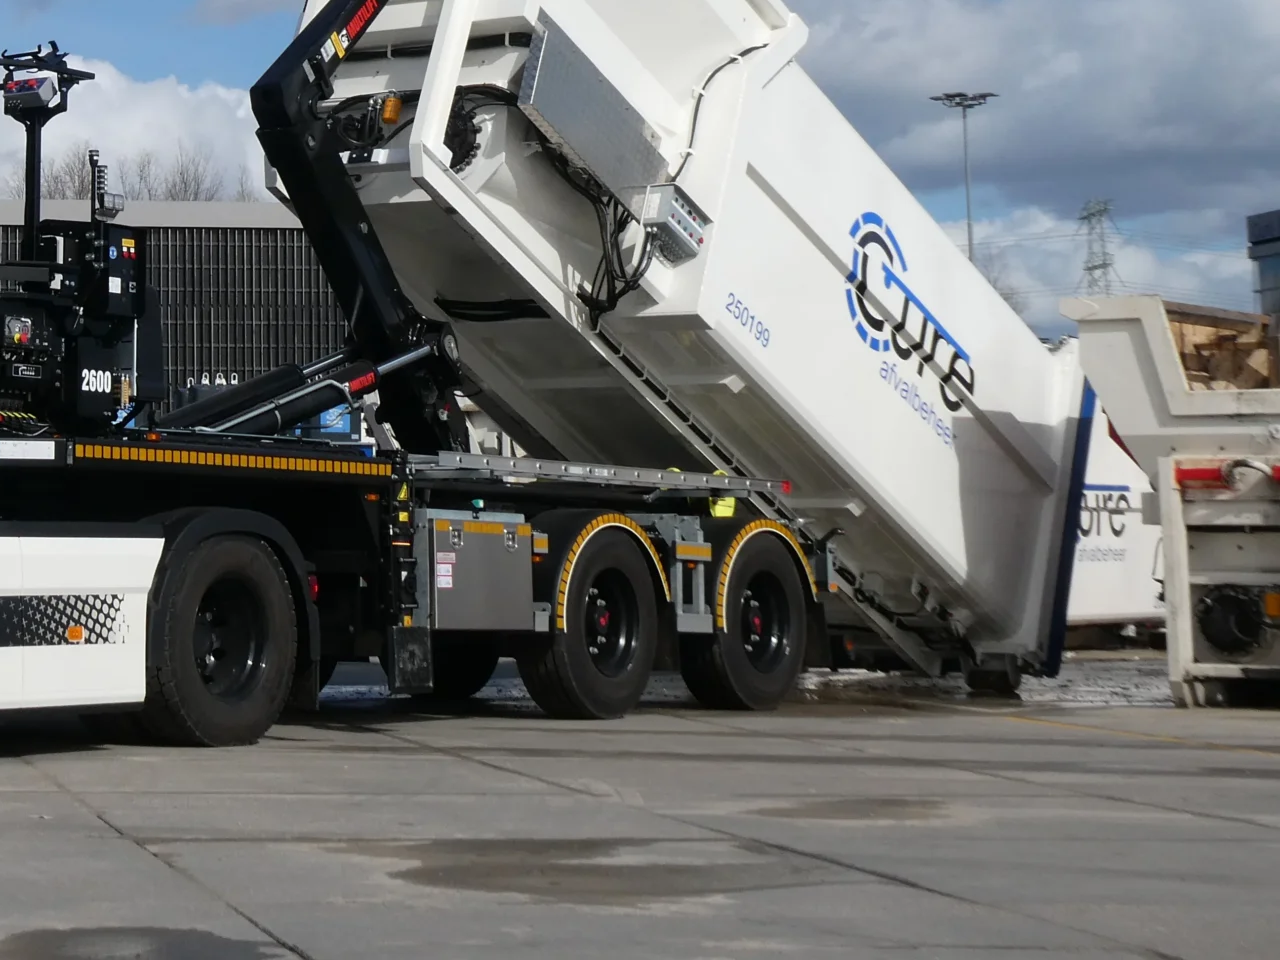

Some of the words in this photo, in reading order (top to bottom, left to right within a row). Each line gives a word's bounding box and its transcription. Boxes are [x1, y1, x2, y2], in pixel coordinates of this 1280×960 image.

[725, 292, 770, 348] 250199
[852, 226, 975, 412] Cure
[81, 368, 112, 393] 2600
[879, 360, 957, 449] afvalbeheer
[1078, 493, 1131, 538] ure
